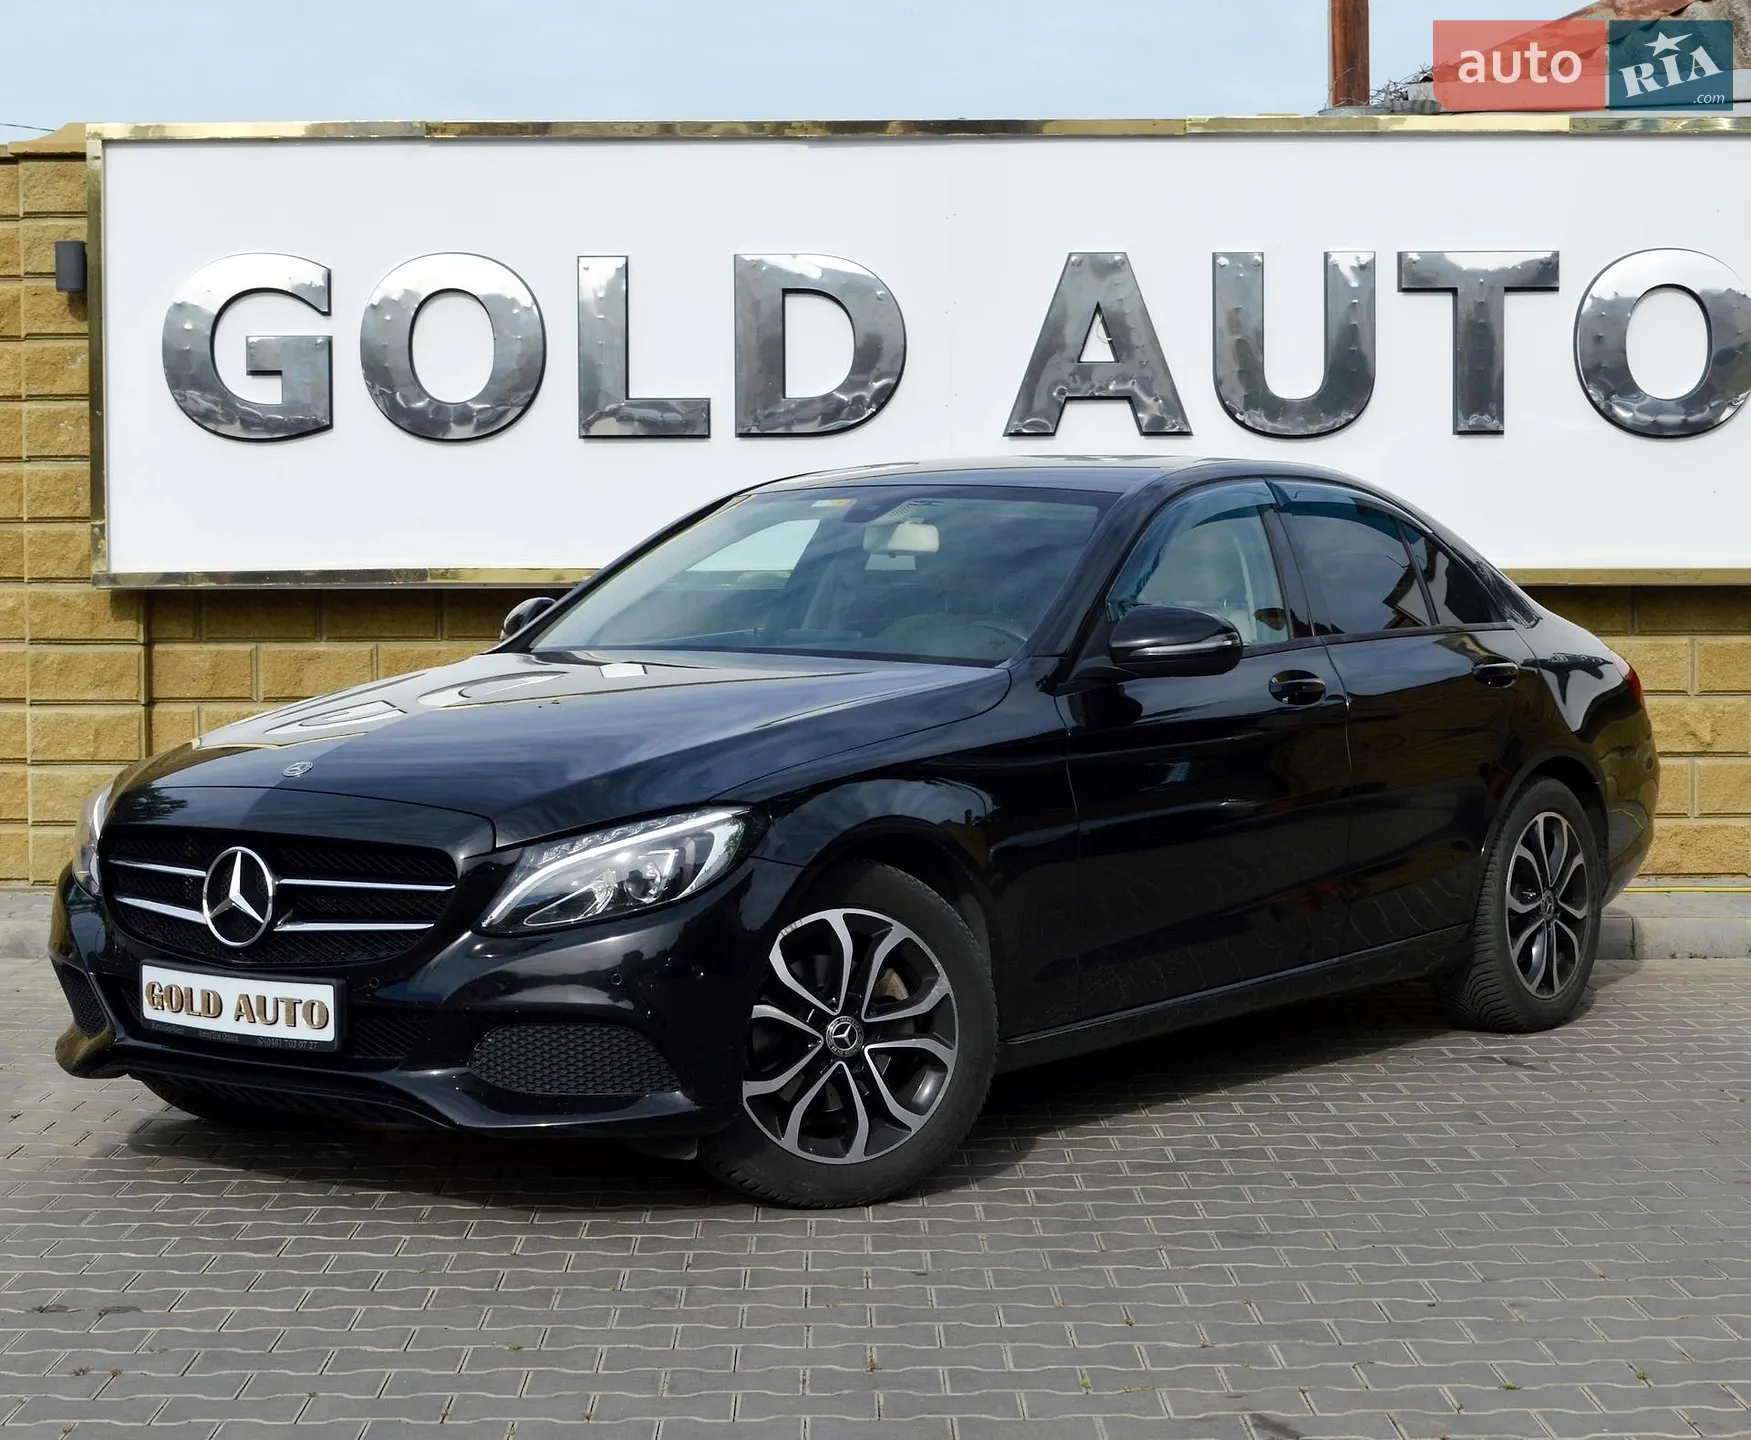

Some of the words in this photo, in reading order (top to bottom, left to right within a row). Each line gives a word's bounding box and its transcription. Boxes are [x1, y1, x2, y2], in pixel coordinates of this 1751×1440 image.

[161, 252, 907, 442] GOLD
[1003, 248, 1751, 439] AUTO
[145, 981, 223, 1018] GOLD
[234, 993, 329, 1030] AUTO
